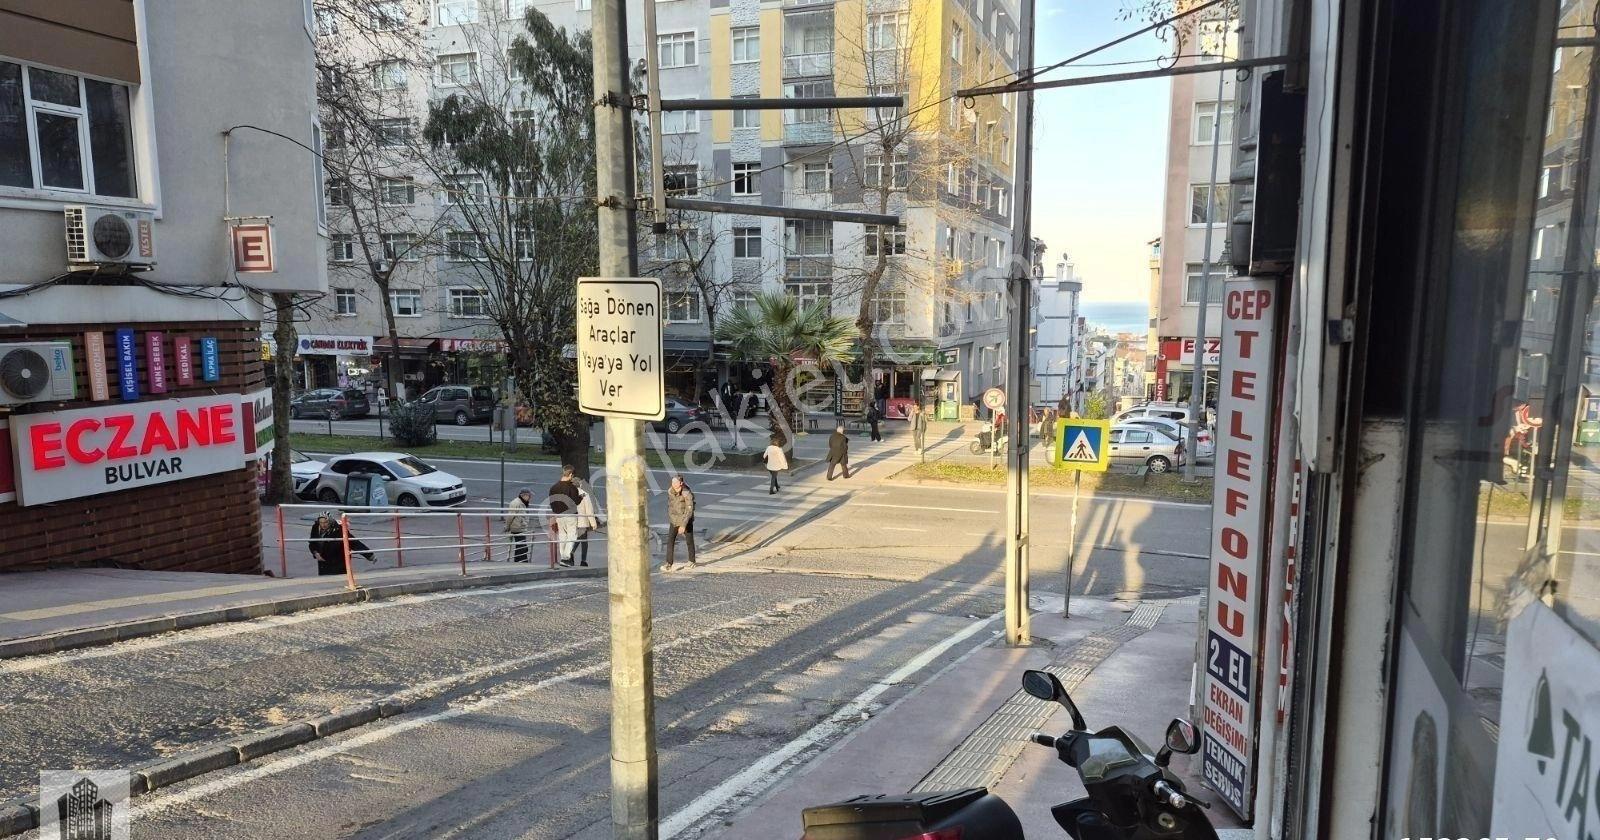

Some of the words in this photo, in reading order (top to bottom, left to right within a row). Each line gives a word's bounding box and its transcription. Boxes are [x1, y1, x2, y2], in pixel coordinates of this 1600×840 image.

[242, 236, 264, 261] E
[580, 298, 600, 318] Sağa
[607, 297, 654, 316] Dönen
[1226, 289, 1271, 320] CEP
[122, 335, 131, 360] BAKIM
[589, 325, 636, 344] Araçlar
[54, 349, 62, 372] beko
[151, 336, 162, 388] ANNE-BEBEK
[180, 344, 189, 379] MEDİKAL
[583, 352, 622, 374] Yaya'ya
[629, 354, 652, 372] Yol
[124, 363, 134, 393] KİŞİSEL
[600, 379, 623, 397] Ver
[30, 404, 236, 470] ECZANE
[105, 457, 183, 485] BULVAR
[1217, 330, 1259, 638] TELEFONU
[1209, 638, 1224, 678] 2.
[1228, 649, 1248, 695] EL
[1211, 682, 1243, 724] EKRAN
[1204, 704, 1248, 758] DEĞİŞİMİ
[1205, 735, 1243, 784] TEKNİK
[1204, 760, 1242, 809] SERVİS
